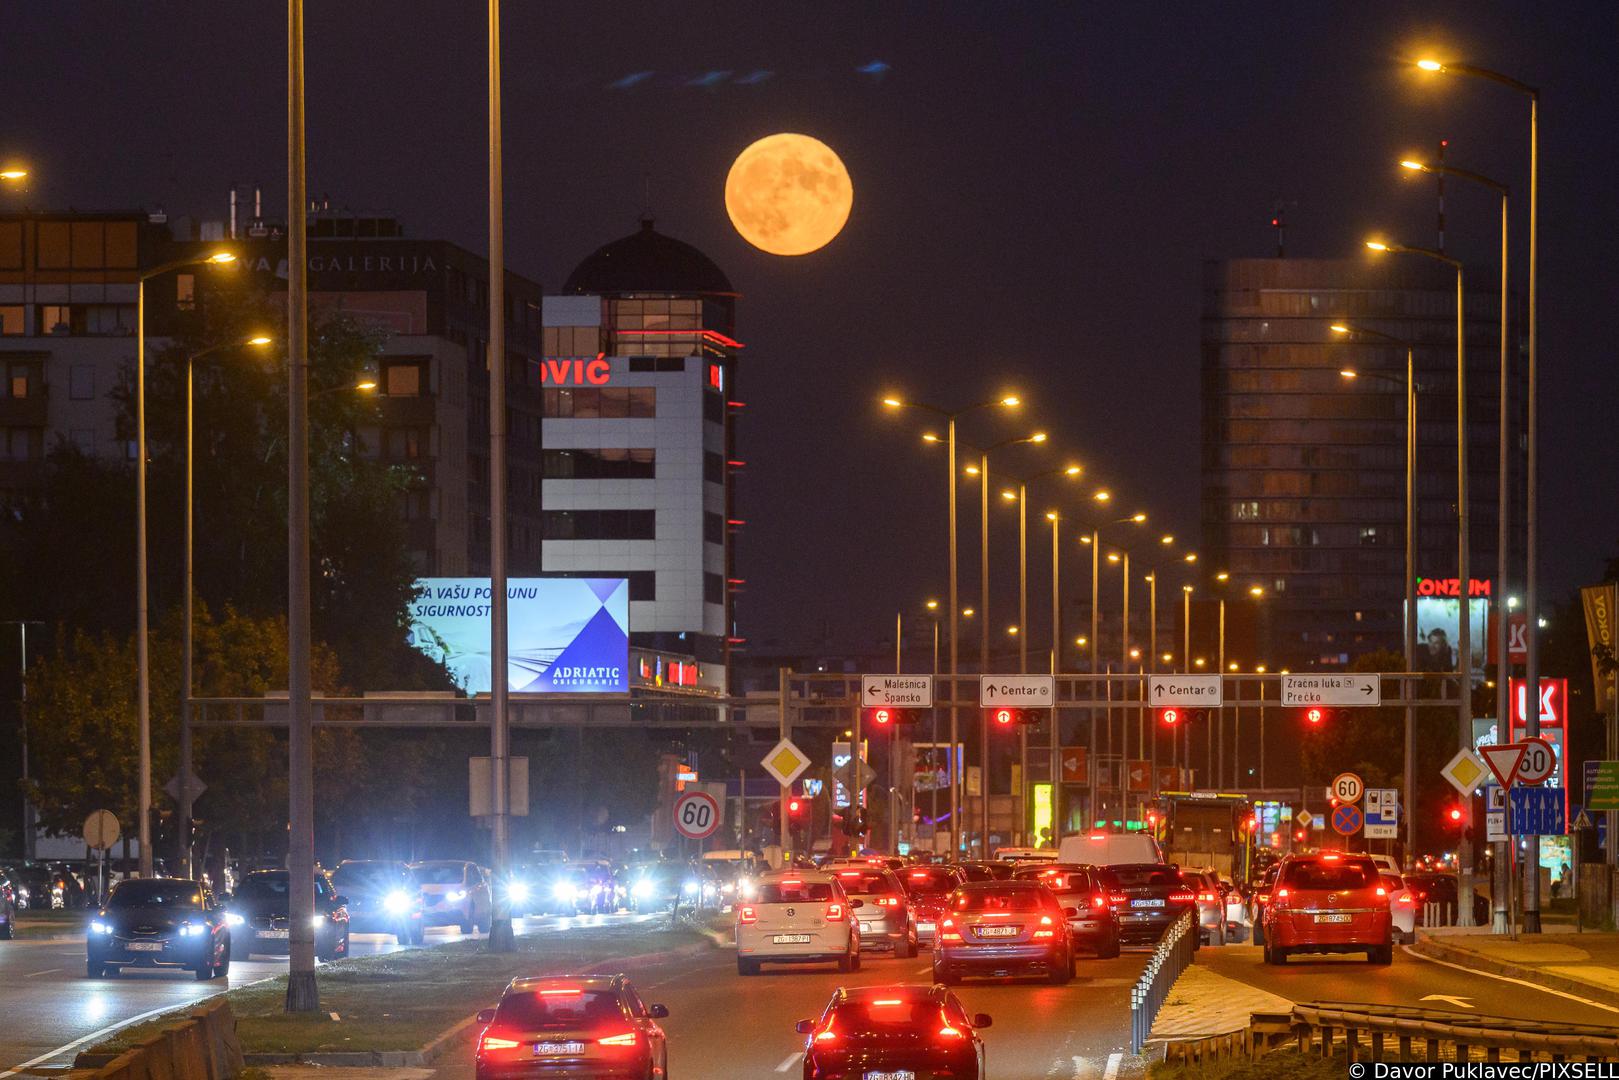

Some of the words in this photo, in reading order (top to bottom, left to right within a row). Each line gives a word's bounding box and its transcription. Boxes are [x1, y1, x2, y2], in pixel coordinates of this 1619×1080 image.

[309, 255, 437, 274] GALERIJA
[437, 584, 470, 599] VAŠU
[474, 587, 538, 599] POUNU
[416, 605, 492, 617] SIGURNOST
[553, 667, 620, 678] ADRIATIC
[884, 678, 927, 689] Malešnica
[1287, 677, 1319, 688] Zračna
[1321, 678, 1341, 688] luka
[1000, 685, 1037, 696] Centar
[1168, 685, 1206, 695] Centar
[884, 690, 921, 703] Špansko
[1287, 691, 1321, 702] Prečko
[1519, 750, 1545, 773] 60
[1338, 780, 1357, 796] 60
[683, 802, 711, 828] 60
